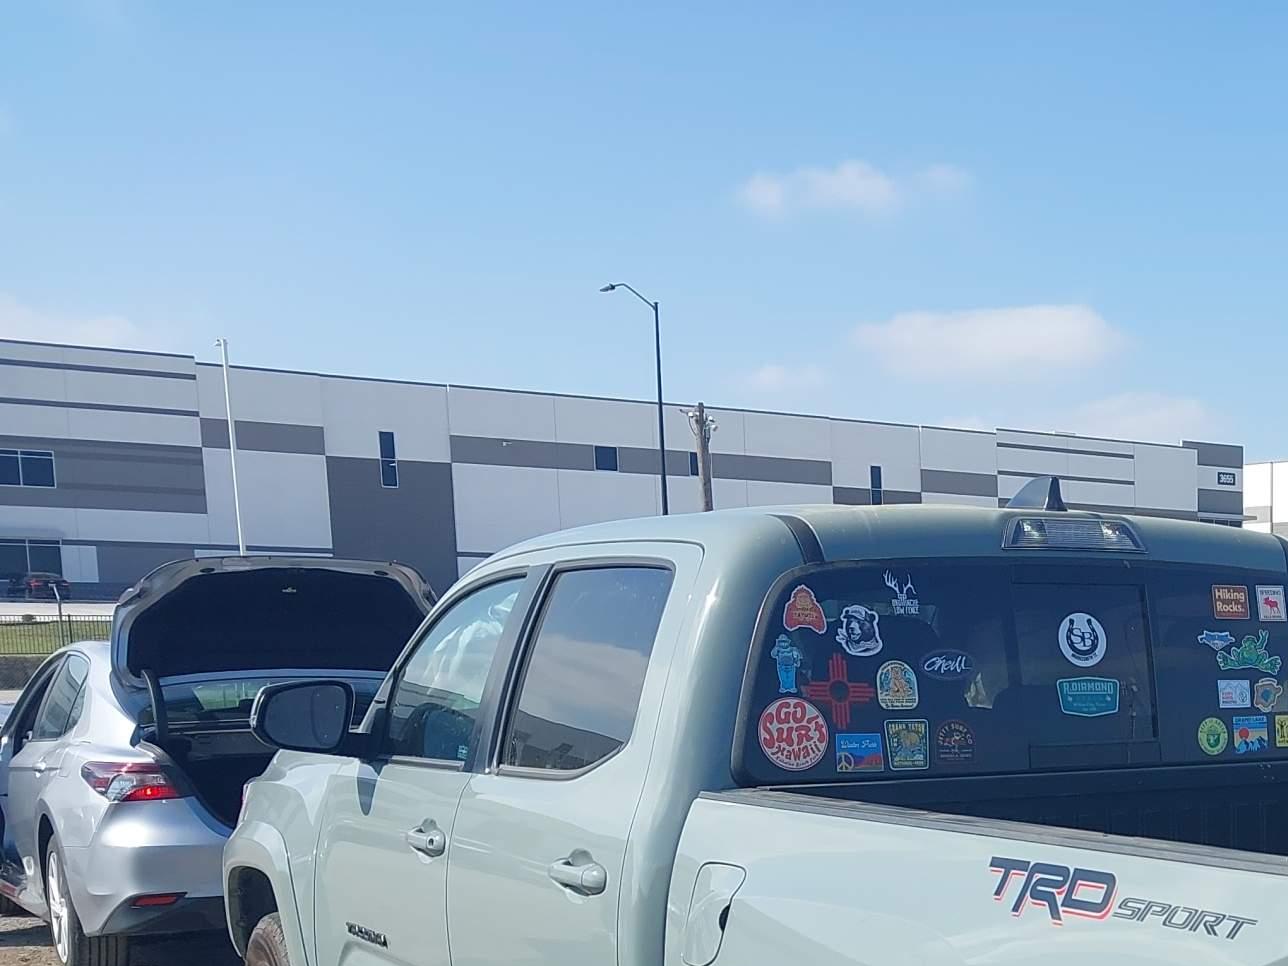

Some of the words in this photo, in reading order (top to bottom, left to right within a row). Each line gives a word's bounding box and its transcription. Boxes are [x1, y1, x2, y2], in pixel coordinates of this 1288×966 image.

[1214, 588, 1245, 602] Hiking
[775, 701, 807, 725] GO
[988, 856, 1120, 928] TRD
[1112, 897, 1259, 940] SPORT
